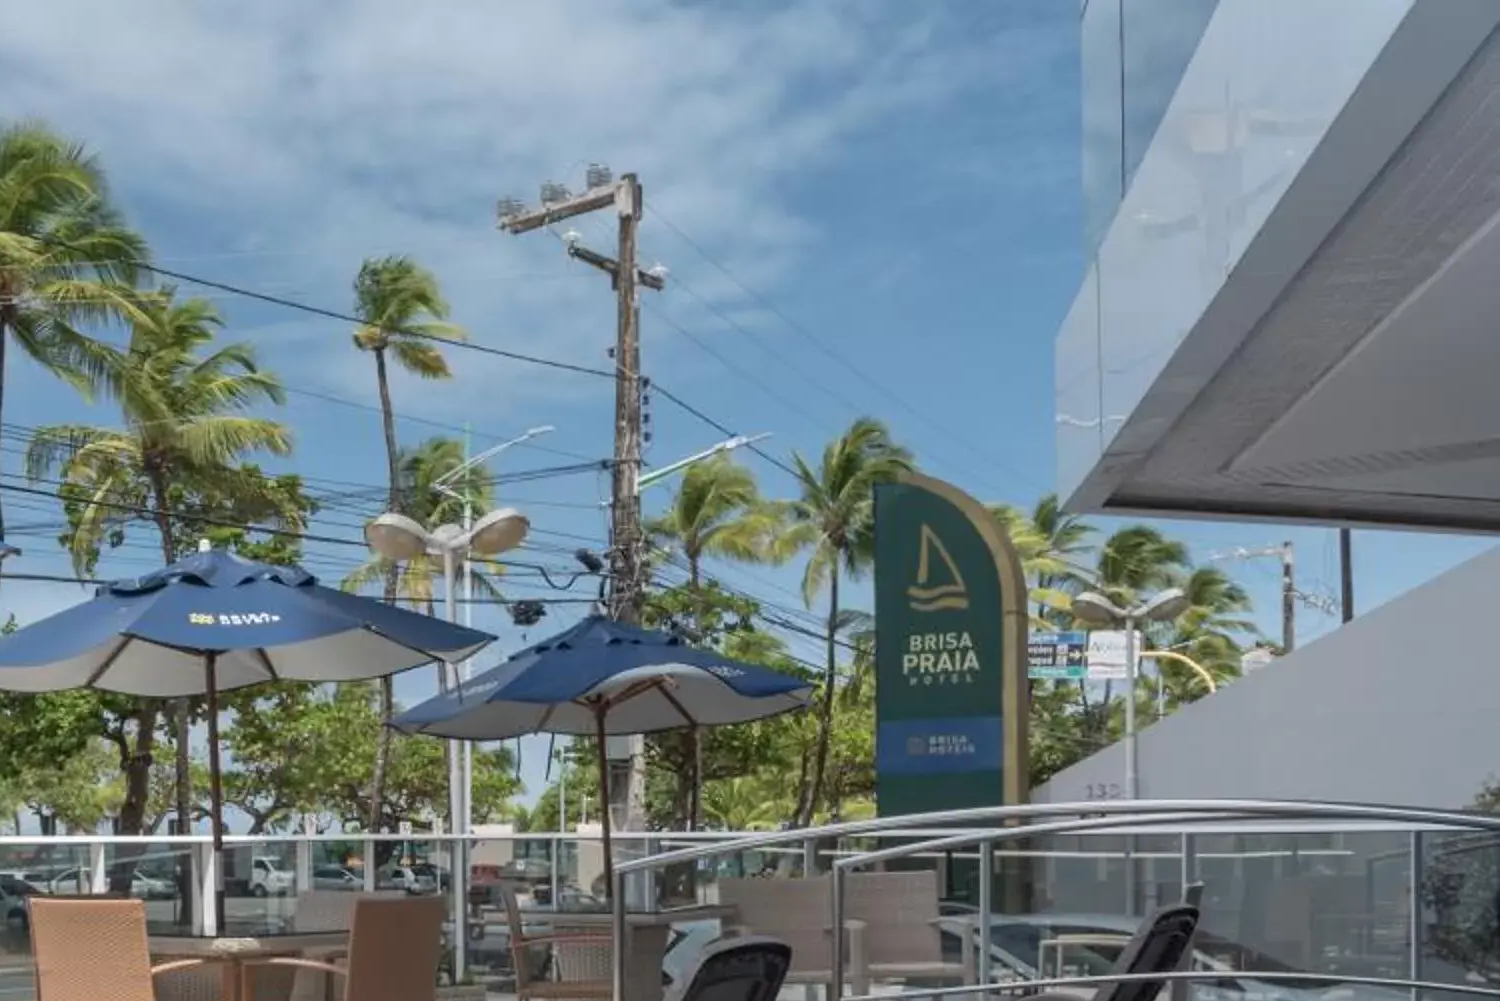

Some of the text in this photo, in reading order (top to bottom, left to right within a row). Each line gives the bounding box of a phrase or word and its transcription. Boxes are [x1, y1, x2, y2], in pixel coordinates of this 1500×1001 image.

[909, 632, 973, 651] BRISA
[902, 652, 980, 675] PRAIA
[909, 673, 975, 686] HOTEL
